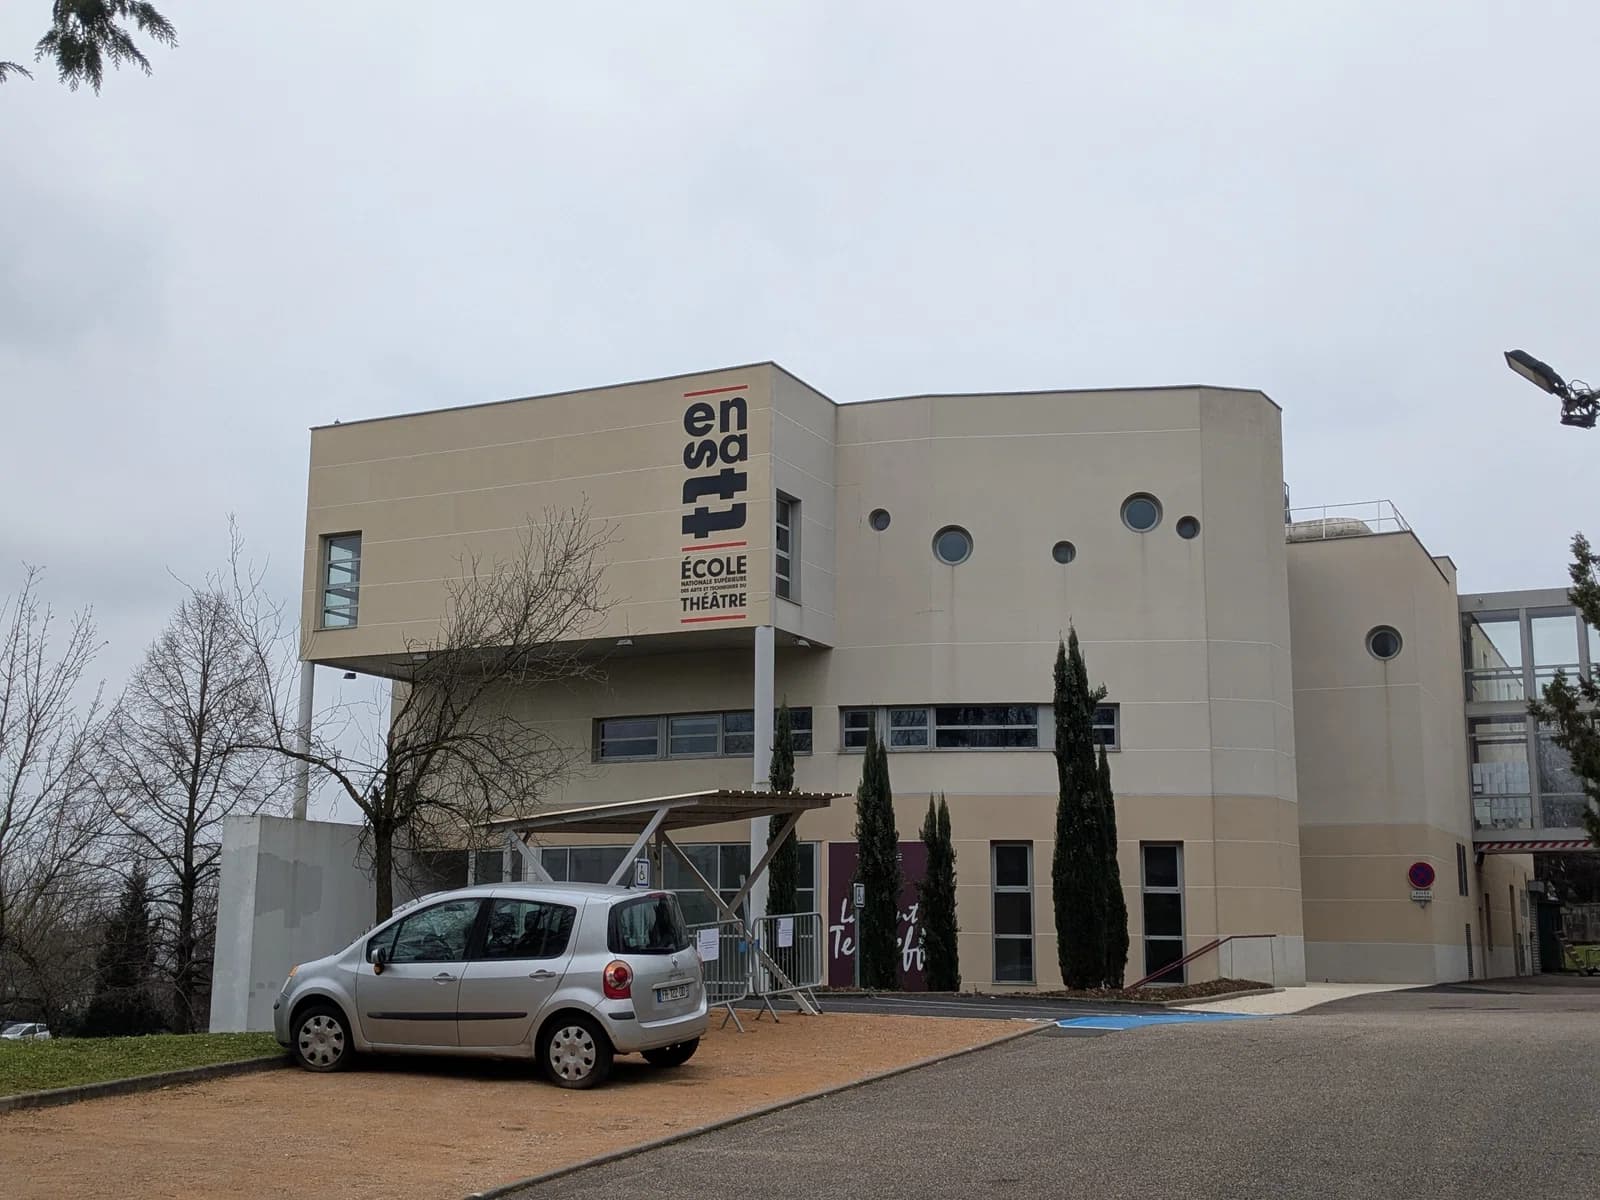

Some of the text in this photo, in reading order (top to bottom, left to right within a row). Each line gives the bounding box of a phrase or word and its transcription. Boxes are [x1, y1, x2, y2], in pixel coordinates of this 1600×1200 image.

[681, 555, 747, 580] ÉCOLE
[681, 579, 713, 587] NATIONALE
[680, 591, 747, 612] THÉÂTRE
